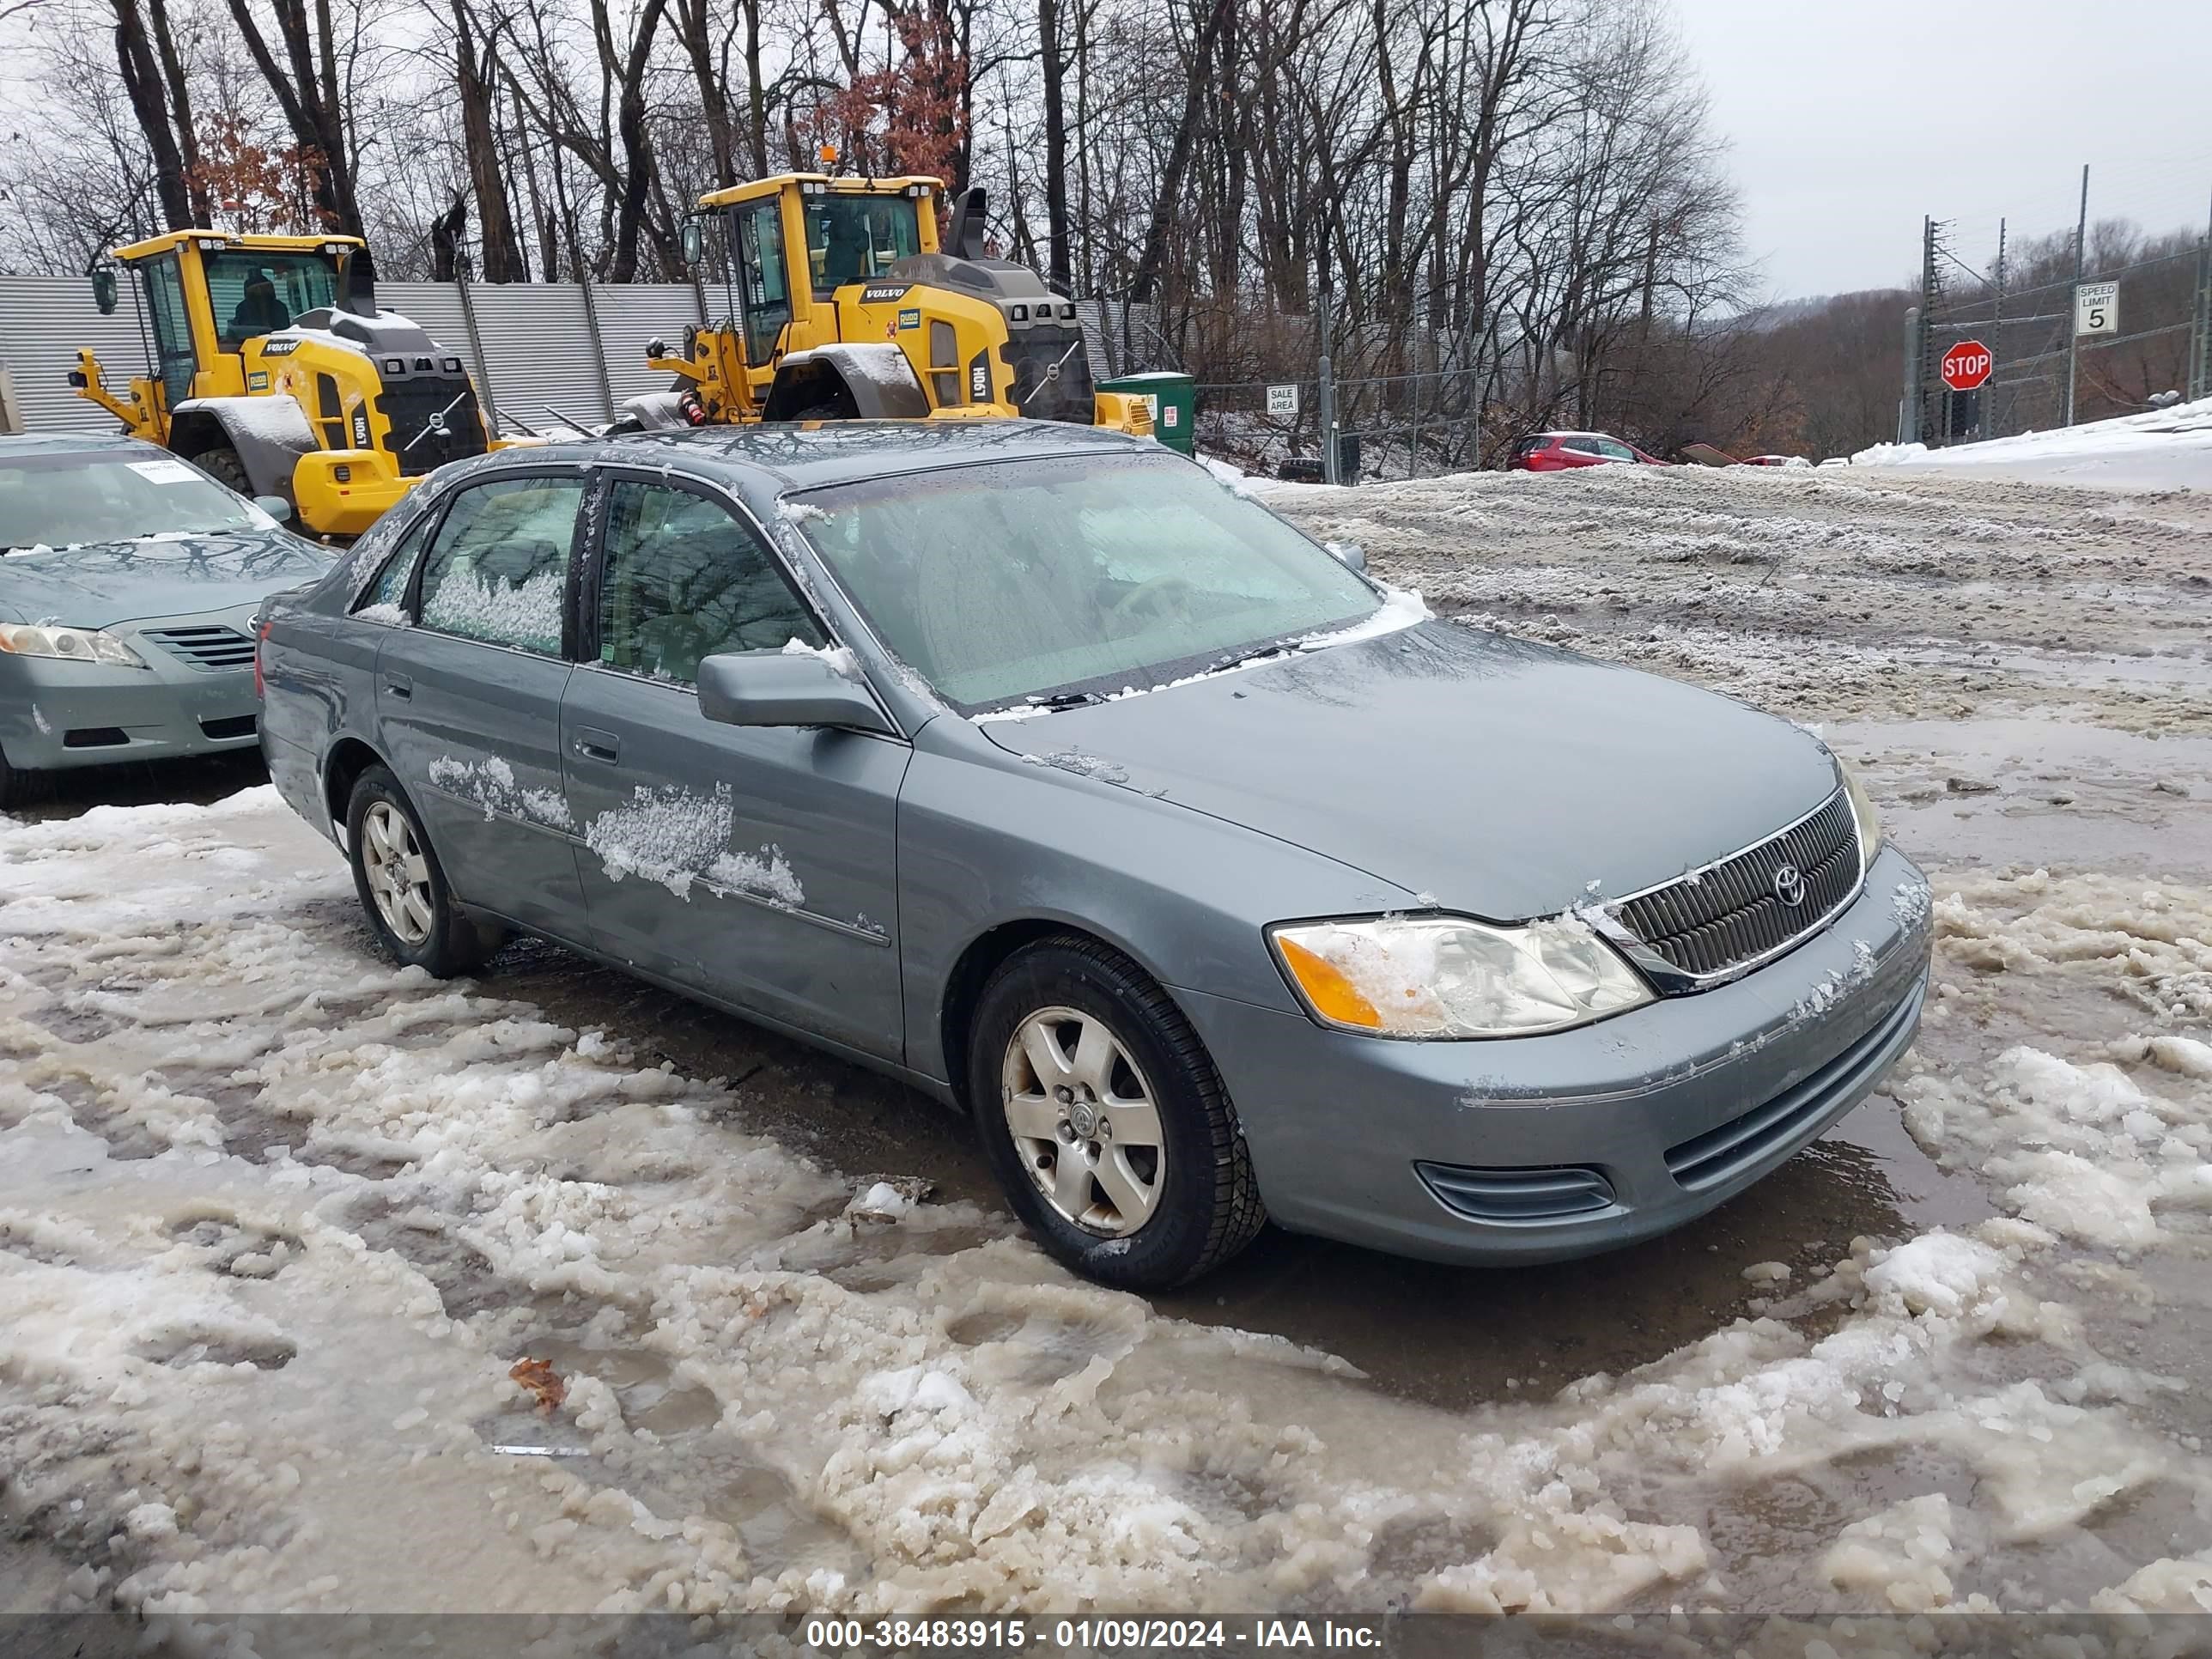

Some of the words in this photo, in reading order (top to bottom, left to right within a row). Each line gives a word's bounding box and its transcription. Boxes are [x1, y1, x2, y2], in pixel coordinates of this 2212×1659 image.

[866, 289, 904, 298] VOLVO
[2081, 285, 2115, 297] SPEED
[2083, 296, 2112, 307] LIMIT
[2088, 308, 2105, 328] 5
[266, 343, 296, 352] VOLVO
[1945, 354, 1989, 377] STOP
[973, 367, 987, 397] L90H
[1271, 388, 1293, 399] SALE
[1271, 400, 1294, 410] AREA
[355, 417, 368, 445] L90H
